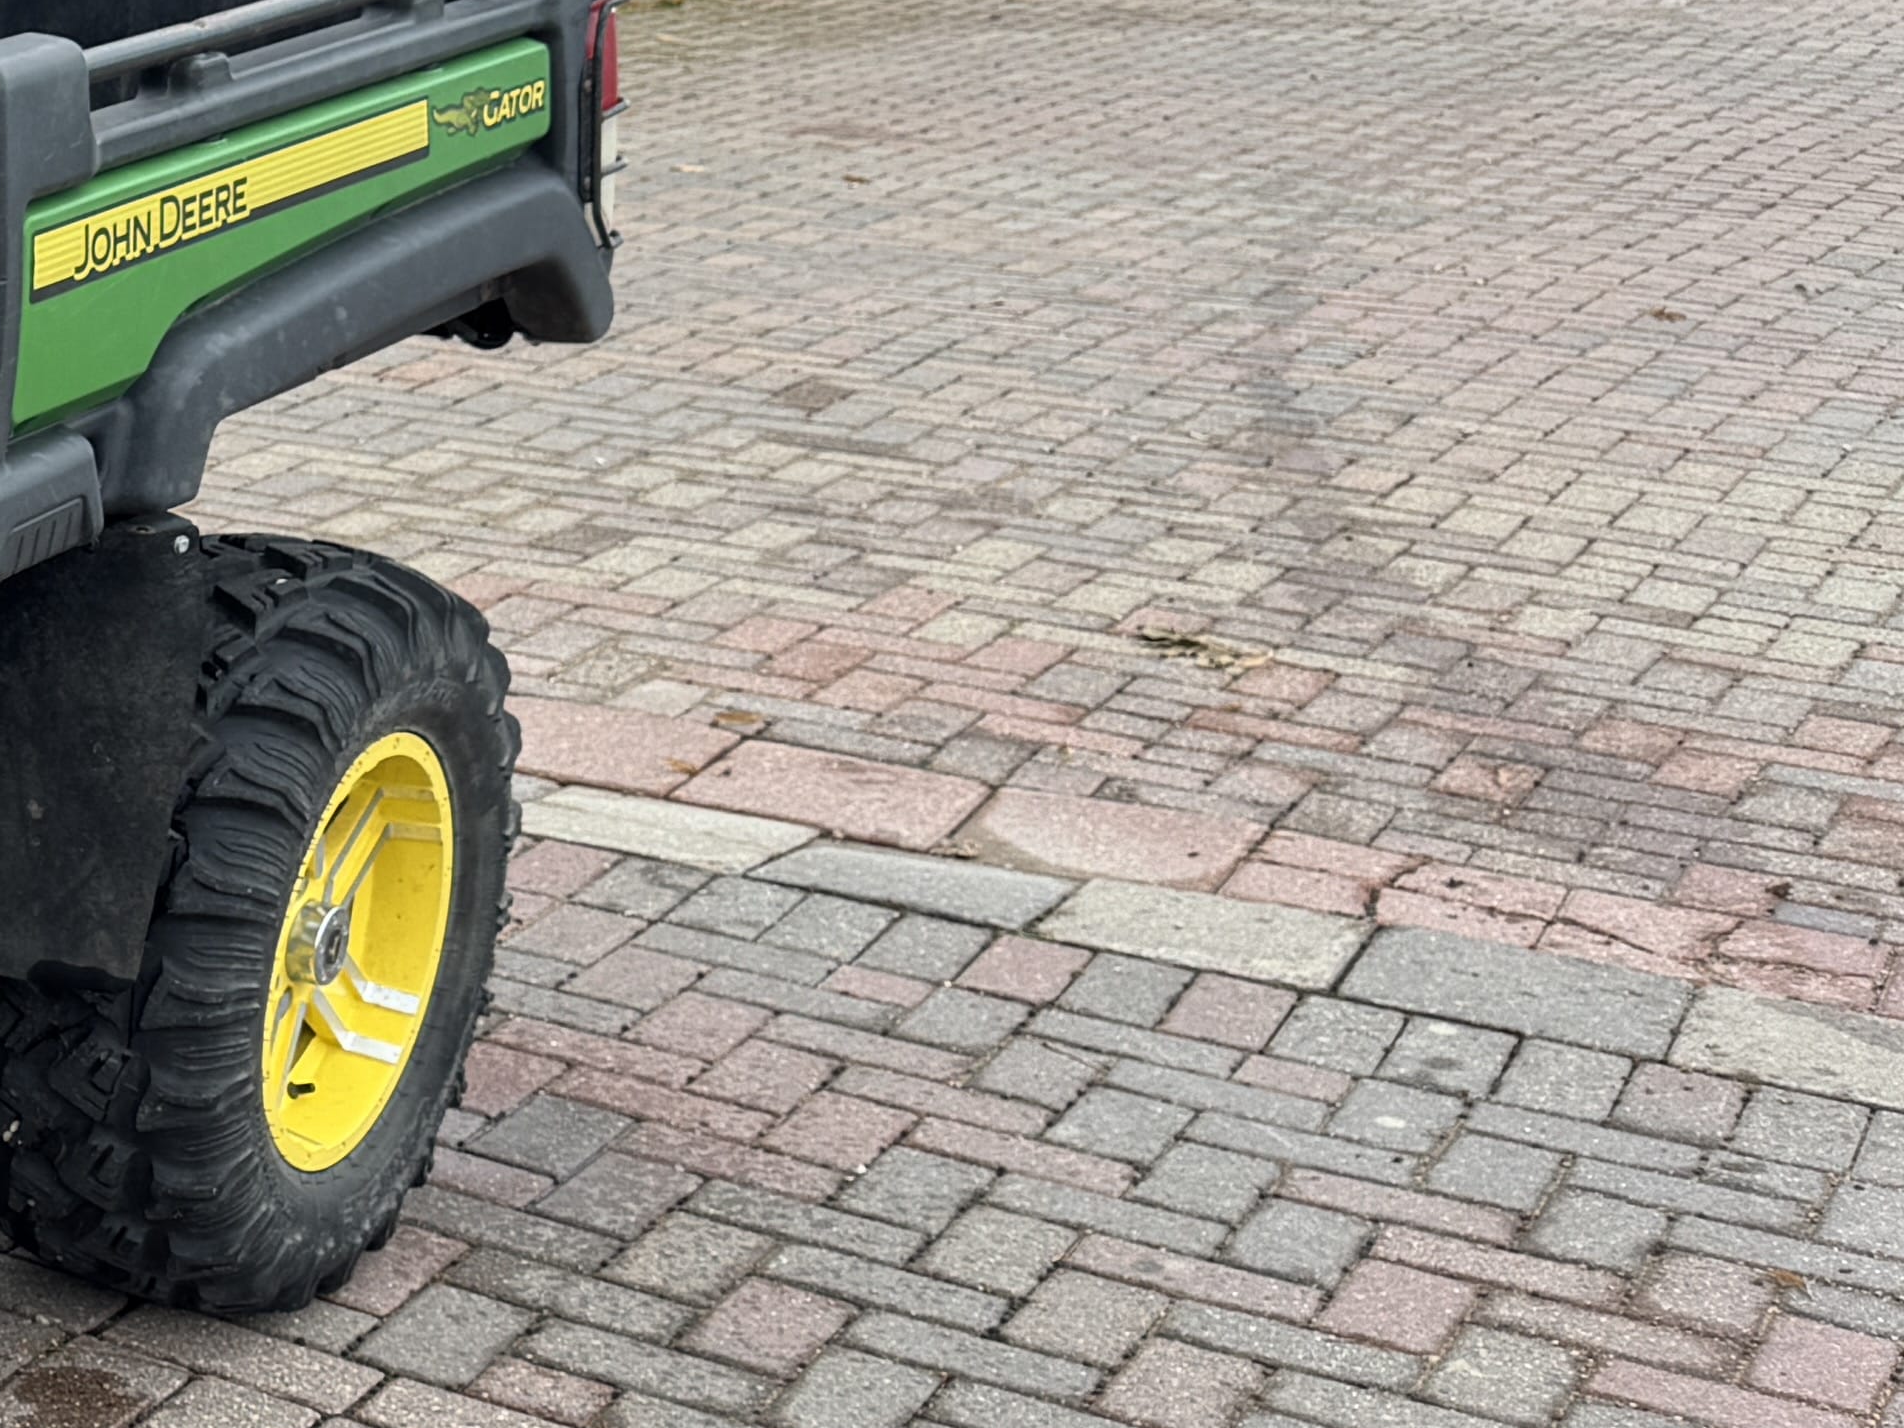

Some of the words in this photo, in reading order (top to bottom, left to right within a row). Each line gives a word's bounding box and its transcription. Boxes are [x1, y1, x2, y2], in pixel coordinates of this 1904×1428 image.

[482, 78, 546, 128] GATOR
[73, 209, 152, 275] JOHN
[158, 175, 249, 244] DEERE
